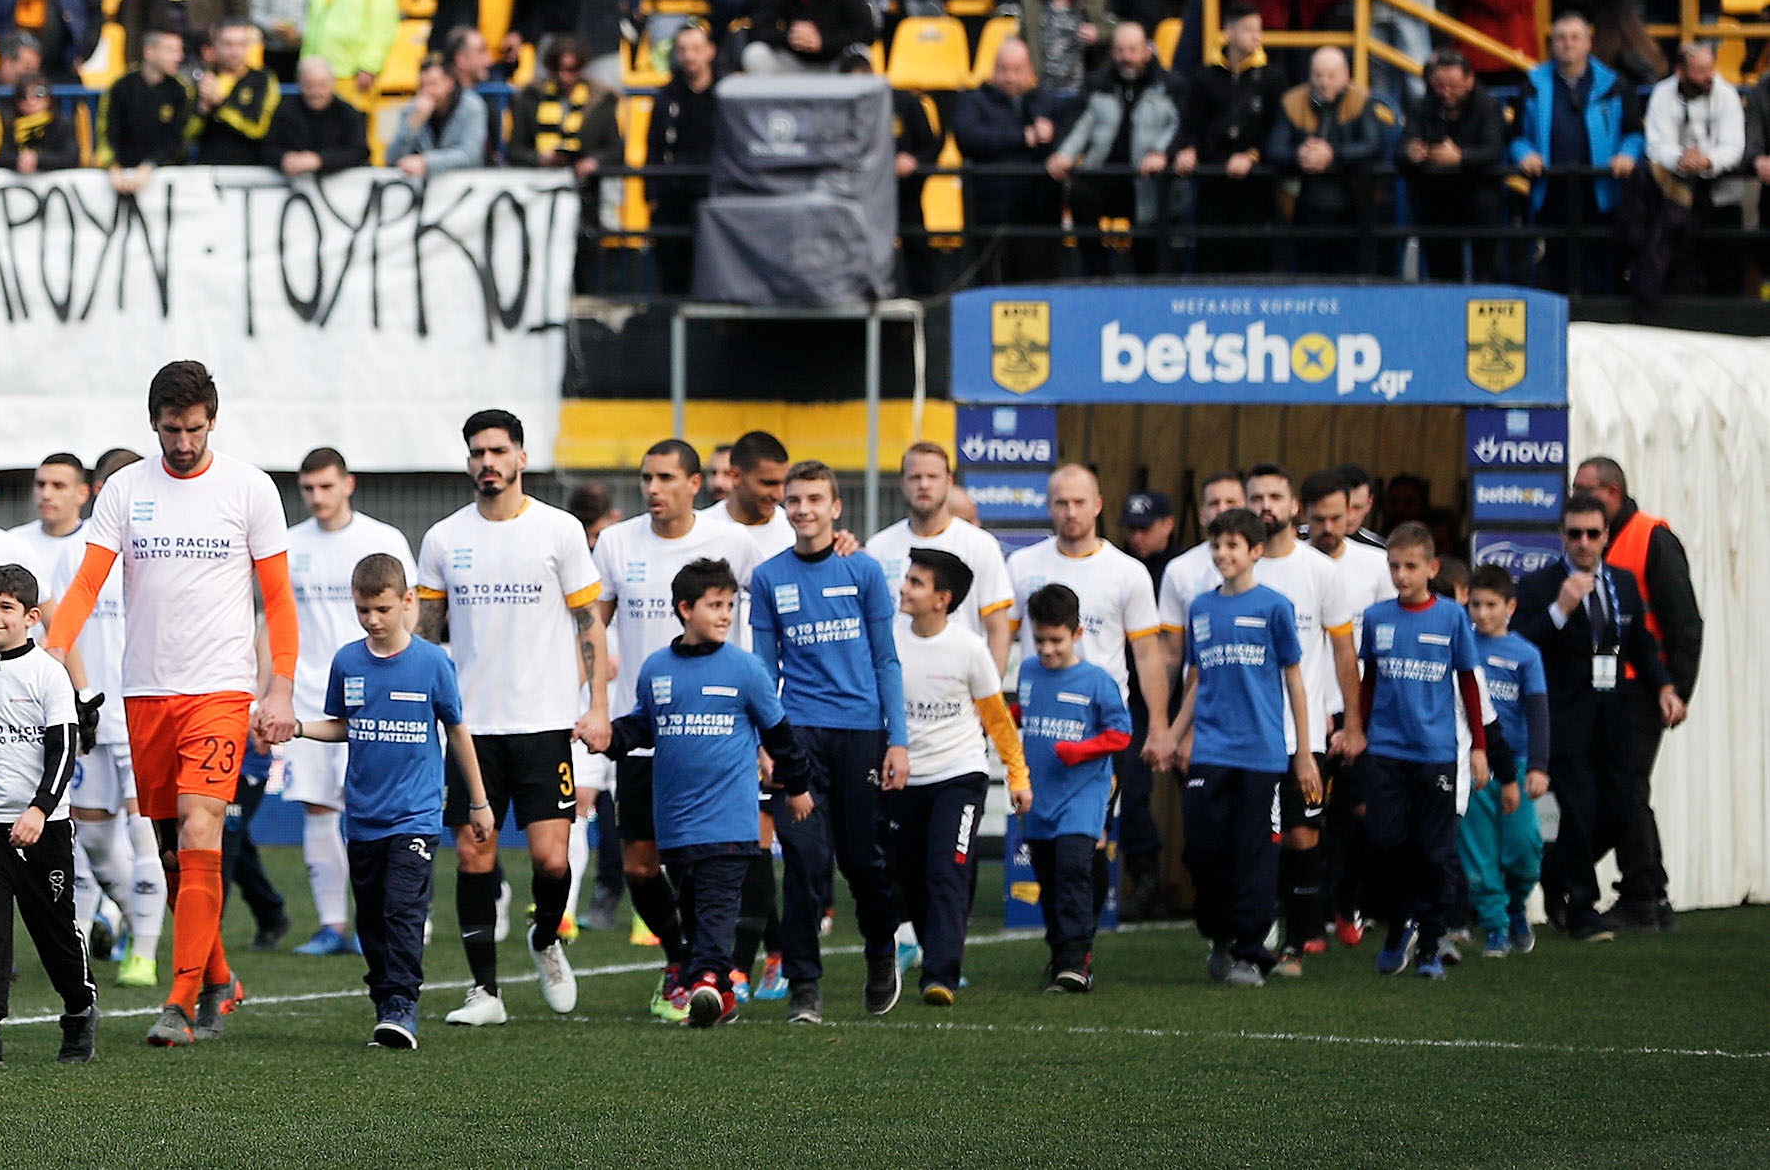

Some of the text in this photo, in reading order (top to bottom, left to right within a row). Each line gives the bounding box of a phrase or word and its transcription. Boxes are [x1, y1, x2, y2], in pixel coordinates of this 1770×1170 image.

[215, 178, 576, 344] ΤΟΥΡΚΟΙ
[987, 439, 1050, 462] nova
[1500, 441, 1564, 463] nova
[153, 537, 170, 547] TO
[176, 537, 230, 549] RACISM
[494, 584, 542, 594] RACISM
[360, 719, 376, 730] TO
[378, 720, 428, 733] RACISM
[685, 713, 734, 727] RACISM
[199, 736, 236, 773] 23
[558, 762, 574, 797] 3
